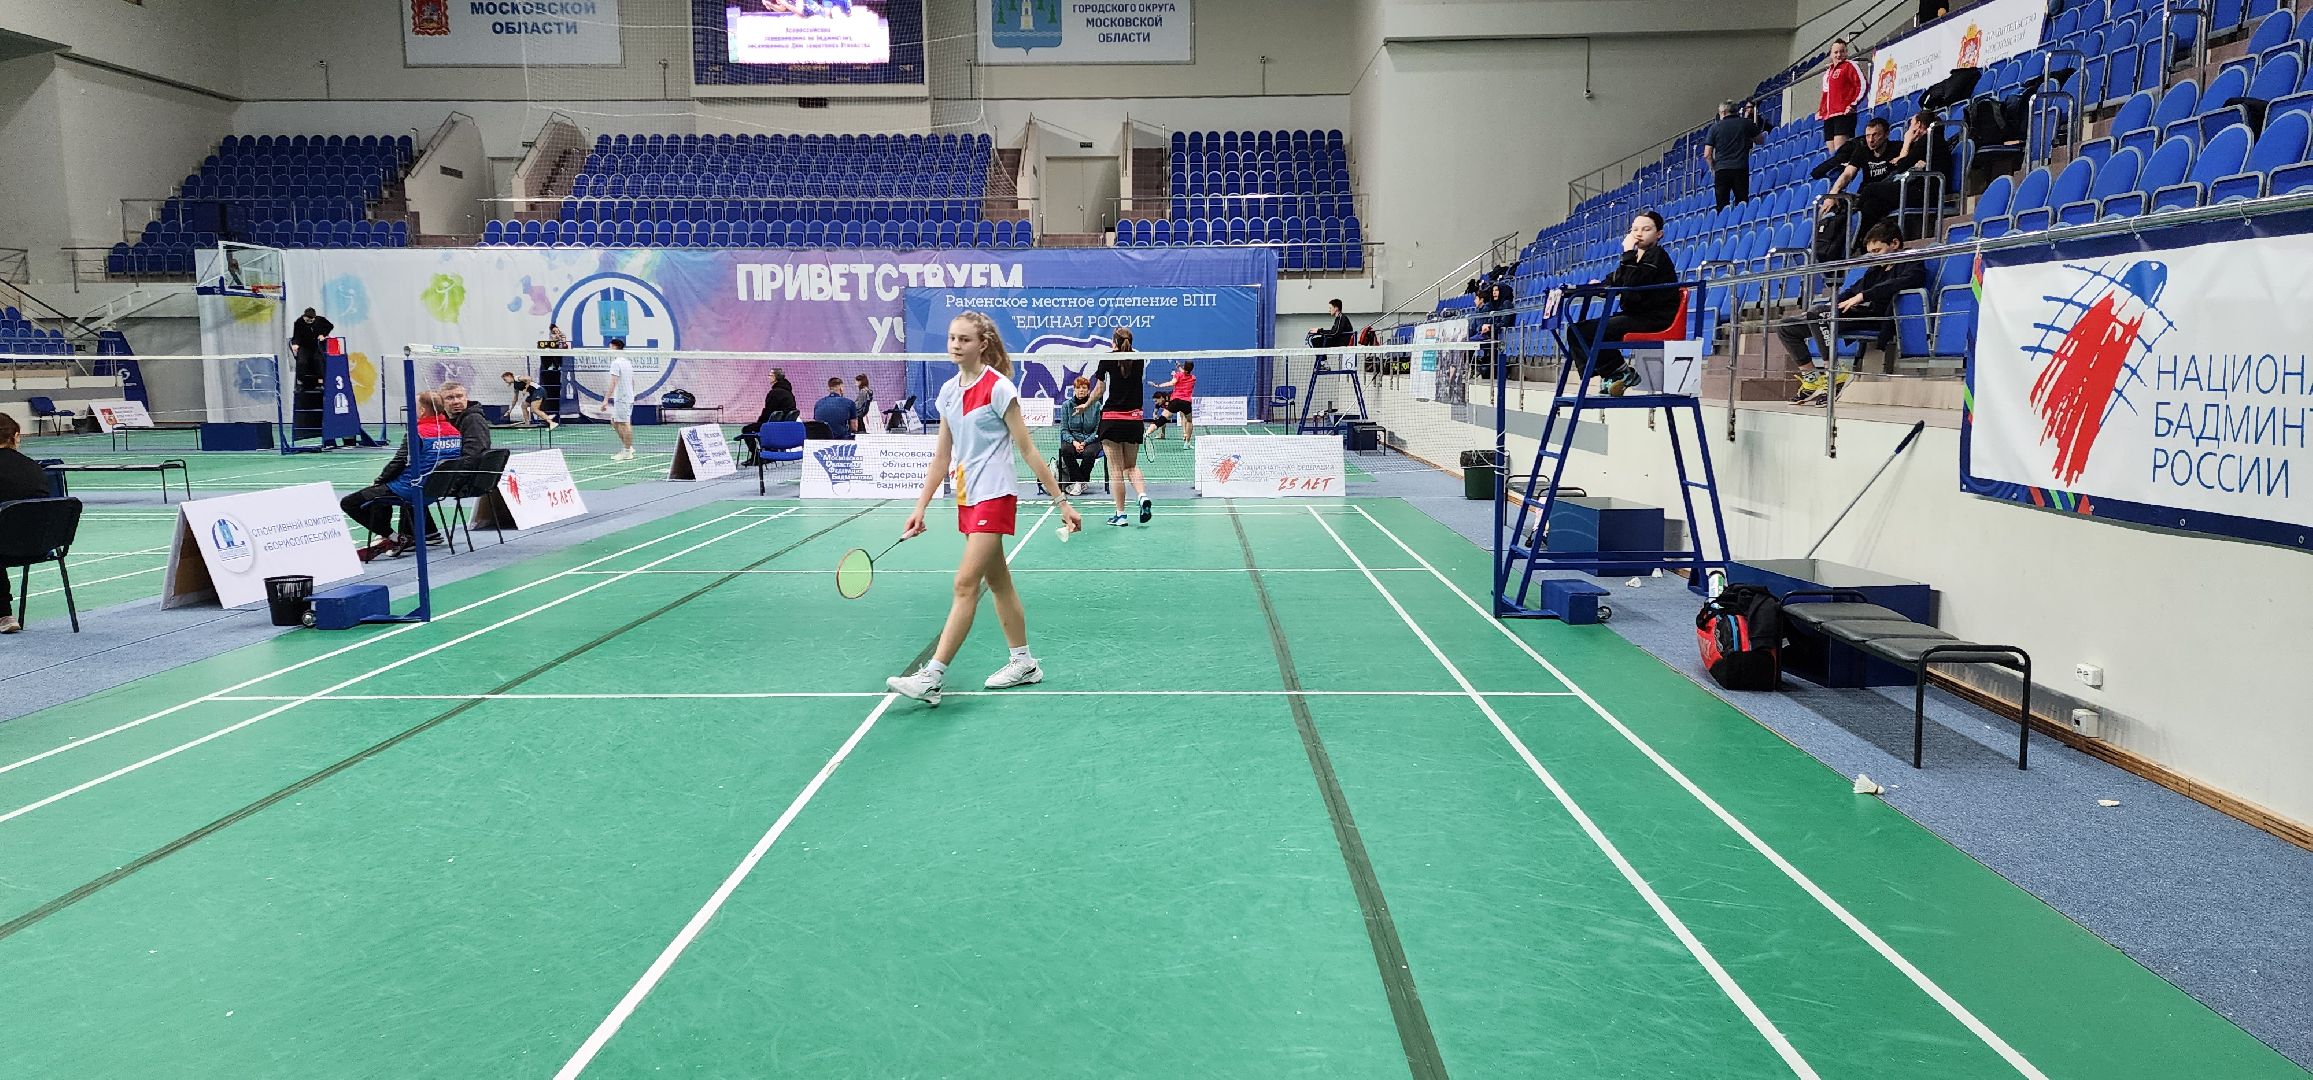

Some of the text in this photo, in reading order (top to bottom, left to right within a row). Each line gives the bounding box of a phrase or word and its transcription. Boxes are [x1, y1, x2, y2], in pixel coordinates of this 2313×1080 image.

[470, 0, 596, 15] МОСКОВСКОЙ
[1072, 3, 1176, 13] ГОРОДСКОГО ОКРУГА
[492, 21, 577, 35] ОБЛАСТИ
[1086, 15, 1163, 27] МОСКОВСКОЙ
[1098, 32, 1150, 43] ОБЛАСТИ
[946, 293, 1217, 308] Раменское местное отделение ВПП
[1011, 315, 1083, 330] "ЕДИНАЯ
[1671, 356, 1694, 393] 7
[2155, 353, 2313, 401] НАЦИОН
[336, 375, 344, 390] 3
[2153, 401, 2313, 449] БАДМИН
[2151, 447, 2290, 499] РОССИИ
[1278, 477, 1336, 492] 25 ЛЕТ
[252, 518, 304, 538] СПОРТИВНЫЙ
